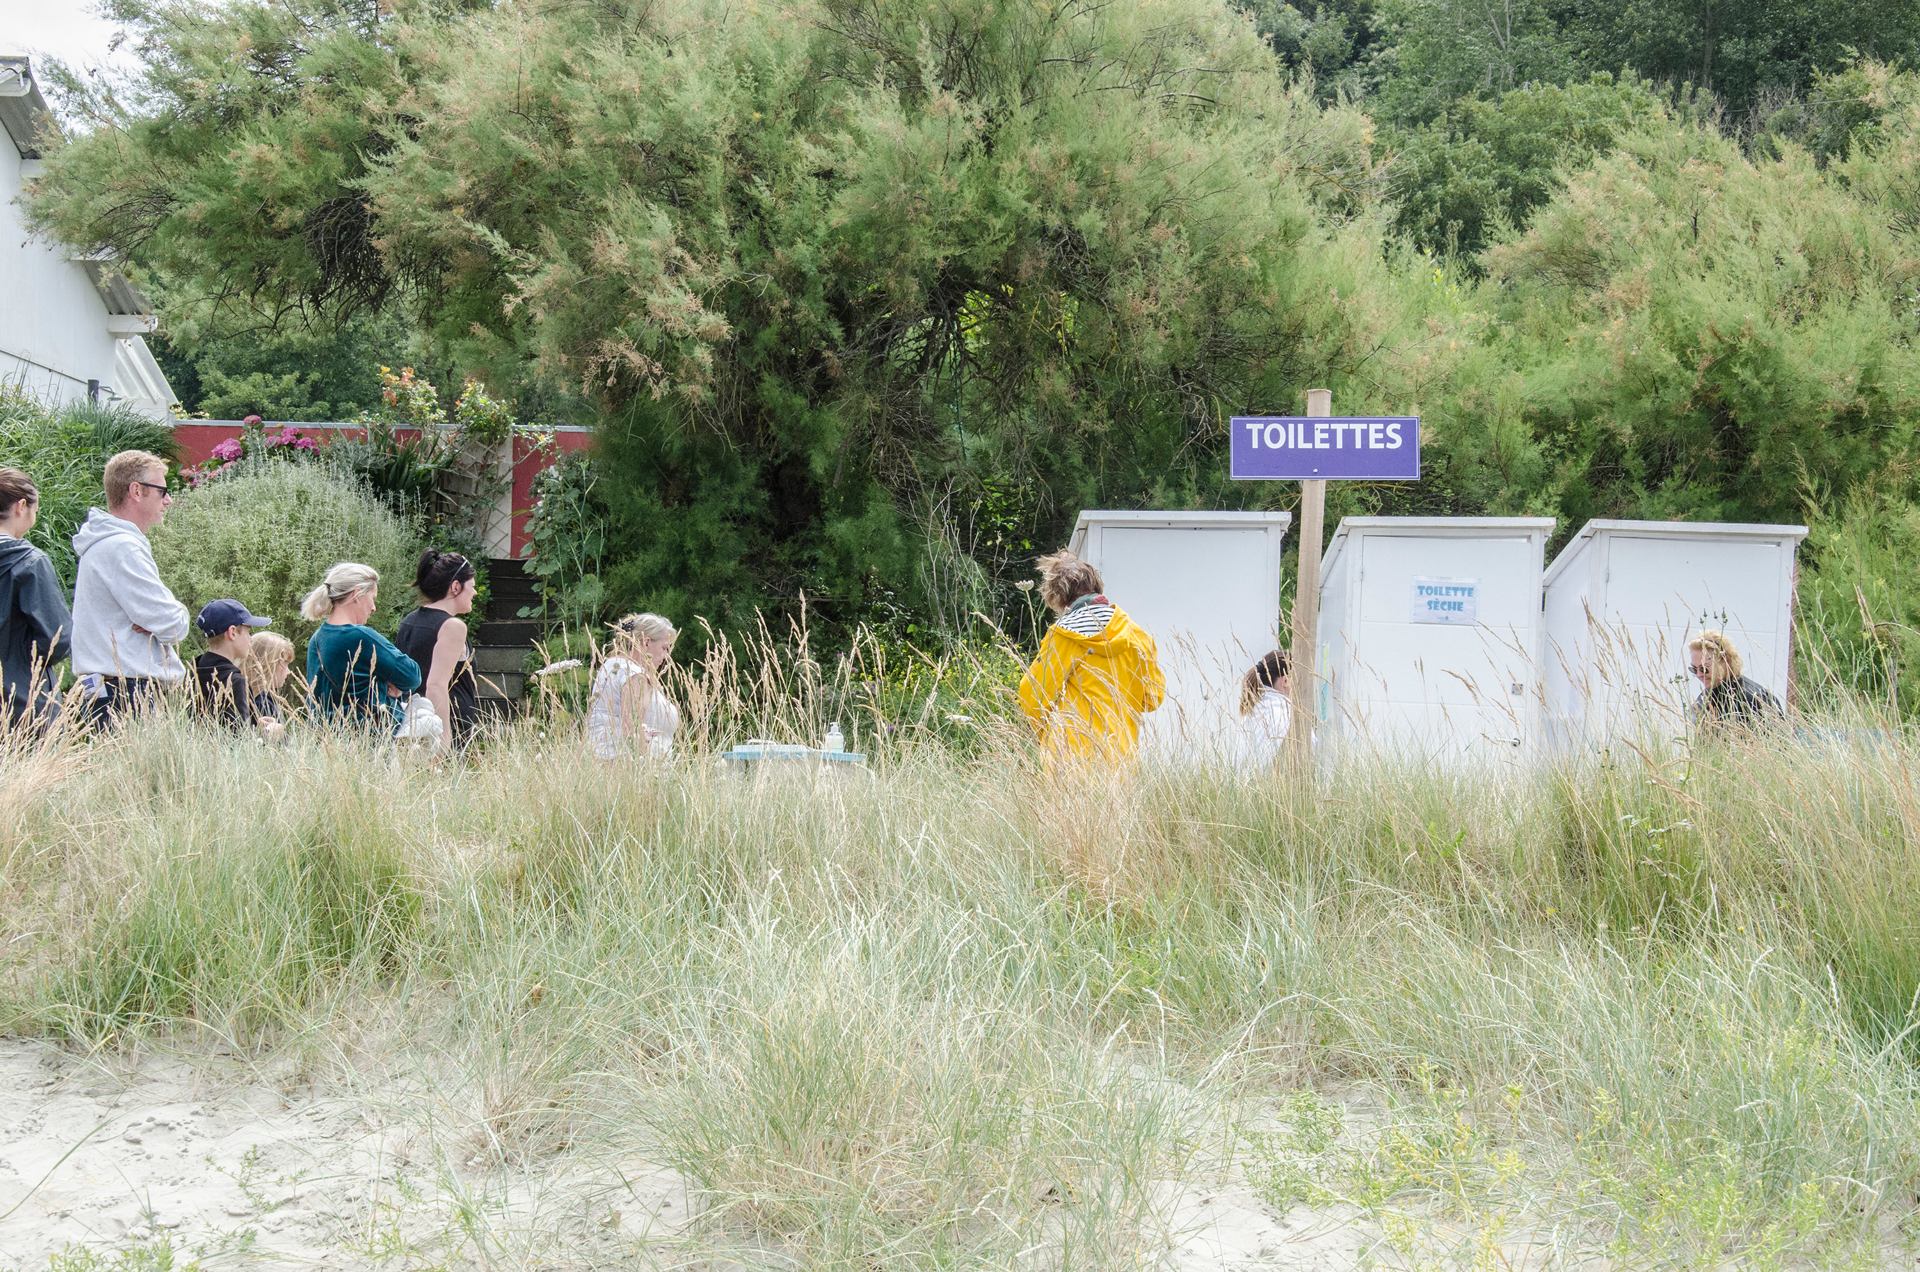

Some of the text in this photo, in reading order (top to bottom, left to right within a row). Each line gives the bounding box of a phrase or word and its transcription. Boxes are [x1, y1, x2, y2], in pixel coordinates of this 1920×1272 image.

[1246, 423, 1403, 449] TOILETTES
[1417, 585, 1474, 597] TOILETTE
[1426, 598, 1464, 612] SÈCHE
